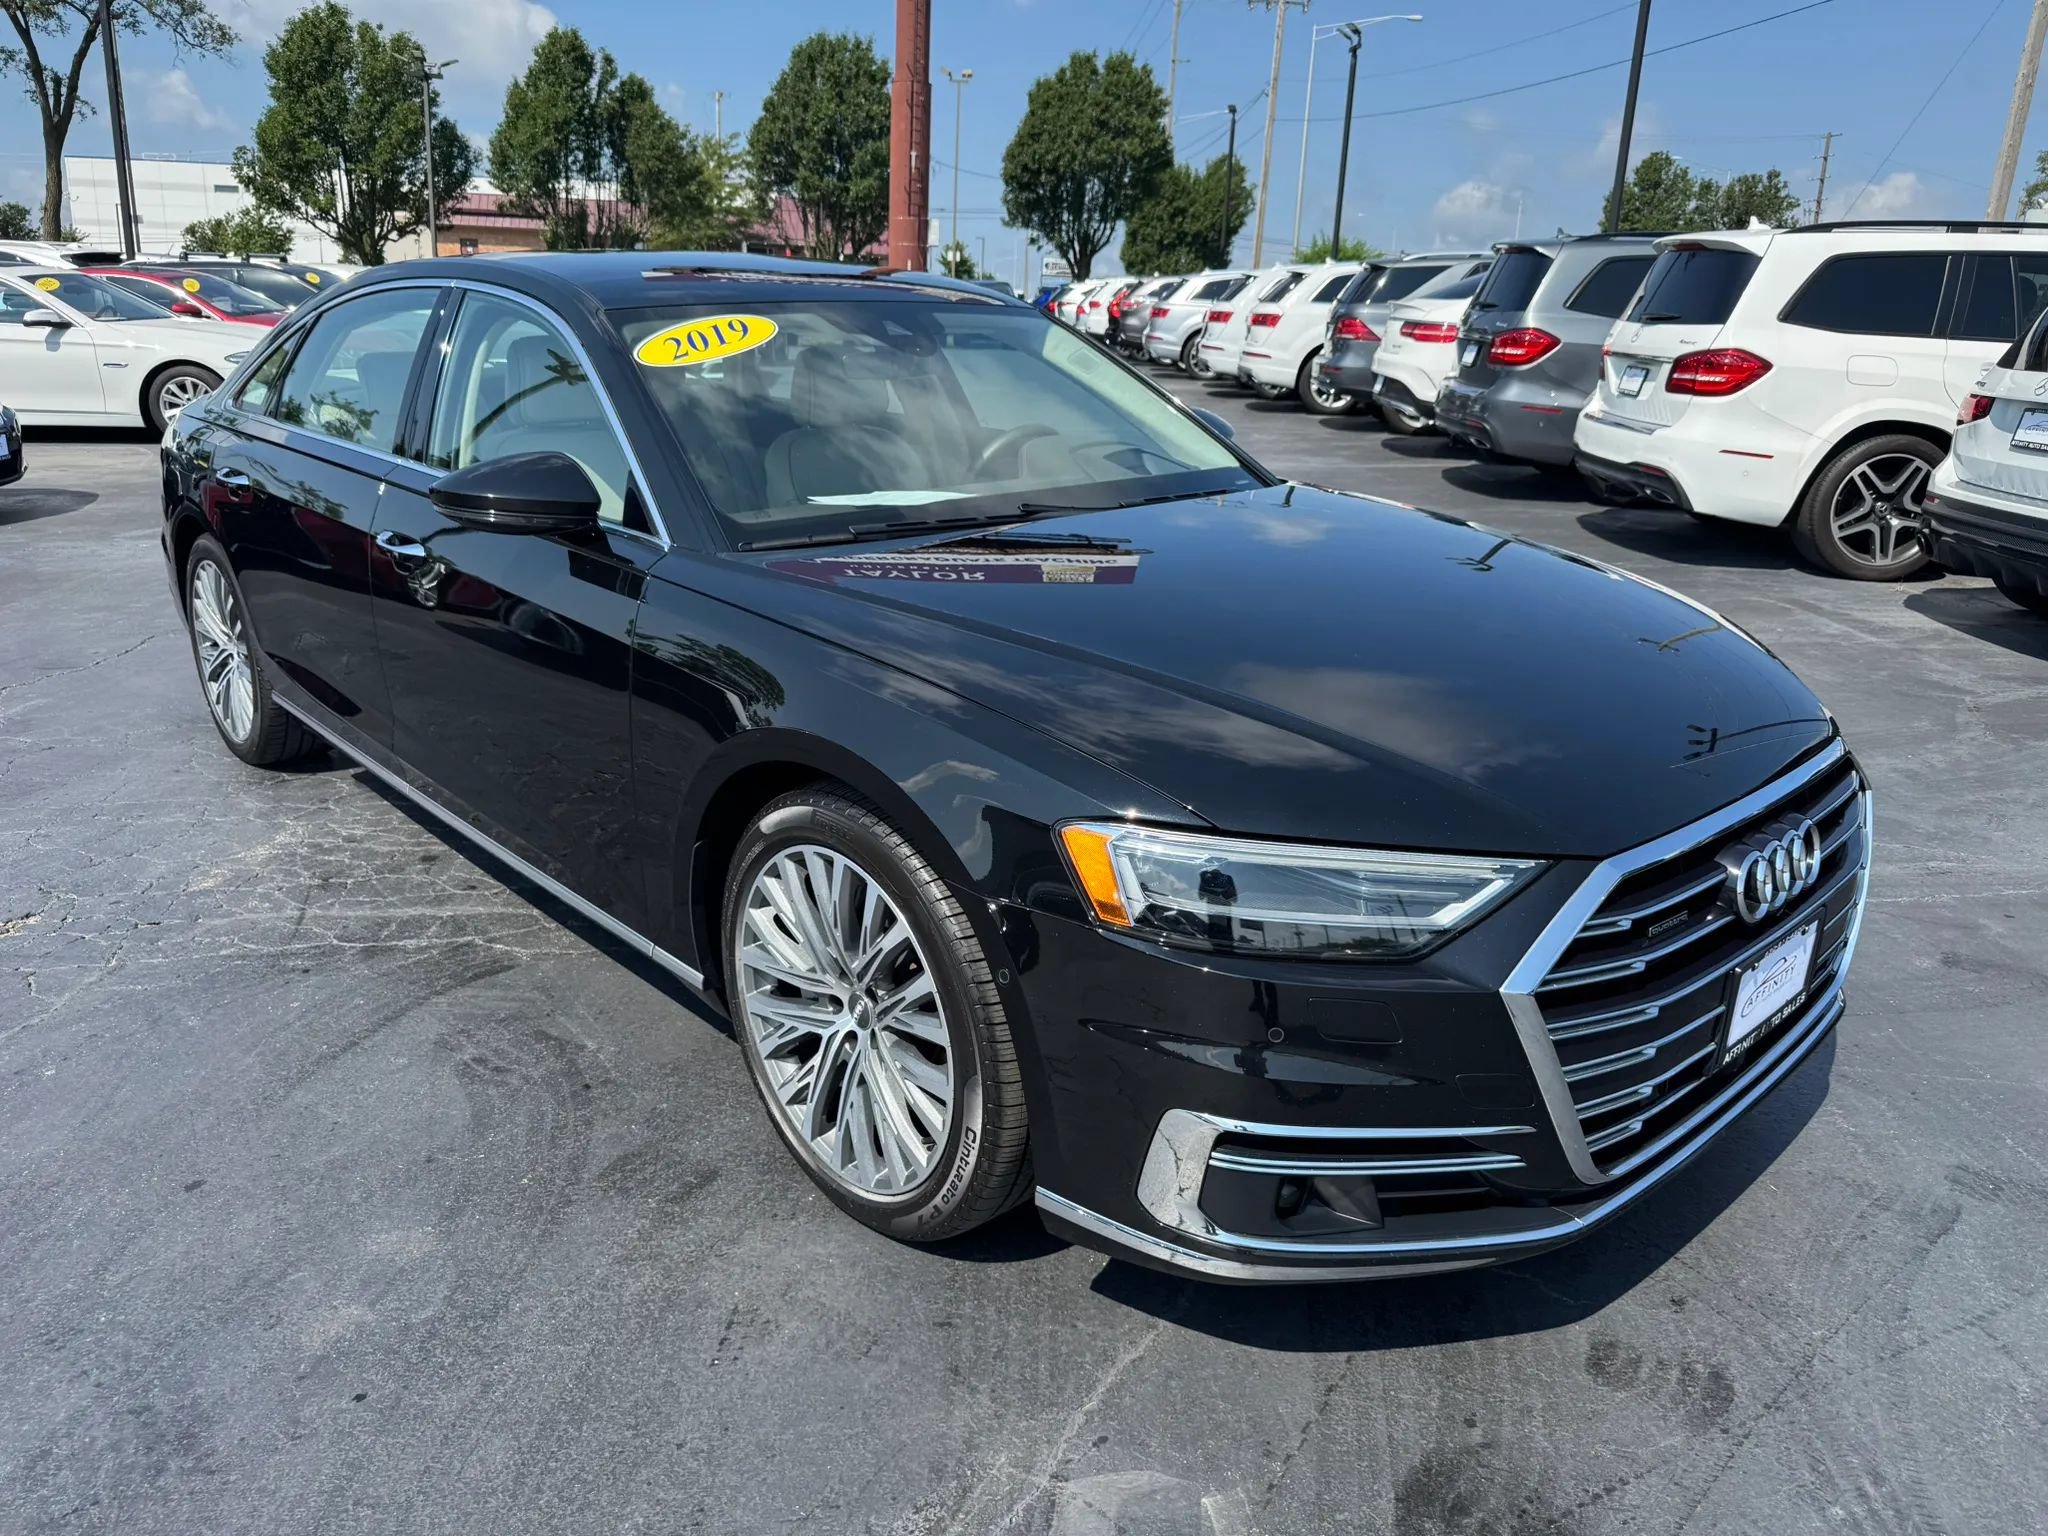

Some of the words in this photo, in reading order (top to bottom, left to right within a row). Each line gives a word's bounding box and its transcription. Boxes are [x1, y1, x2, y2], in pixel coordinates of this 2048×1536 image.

[663, 319, 749, 361] 2019
[1746, 963, 1796, 1009] AFFINITY
[1782, 991, 1806, 1019] SALES
[941, 1125, 977, 1205] Cinturato
